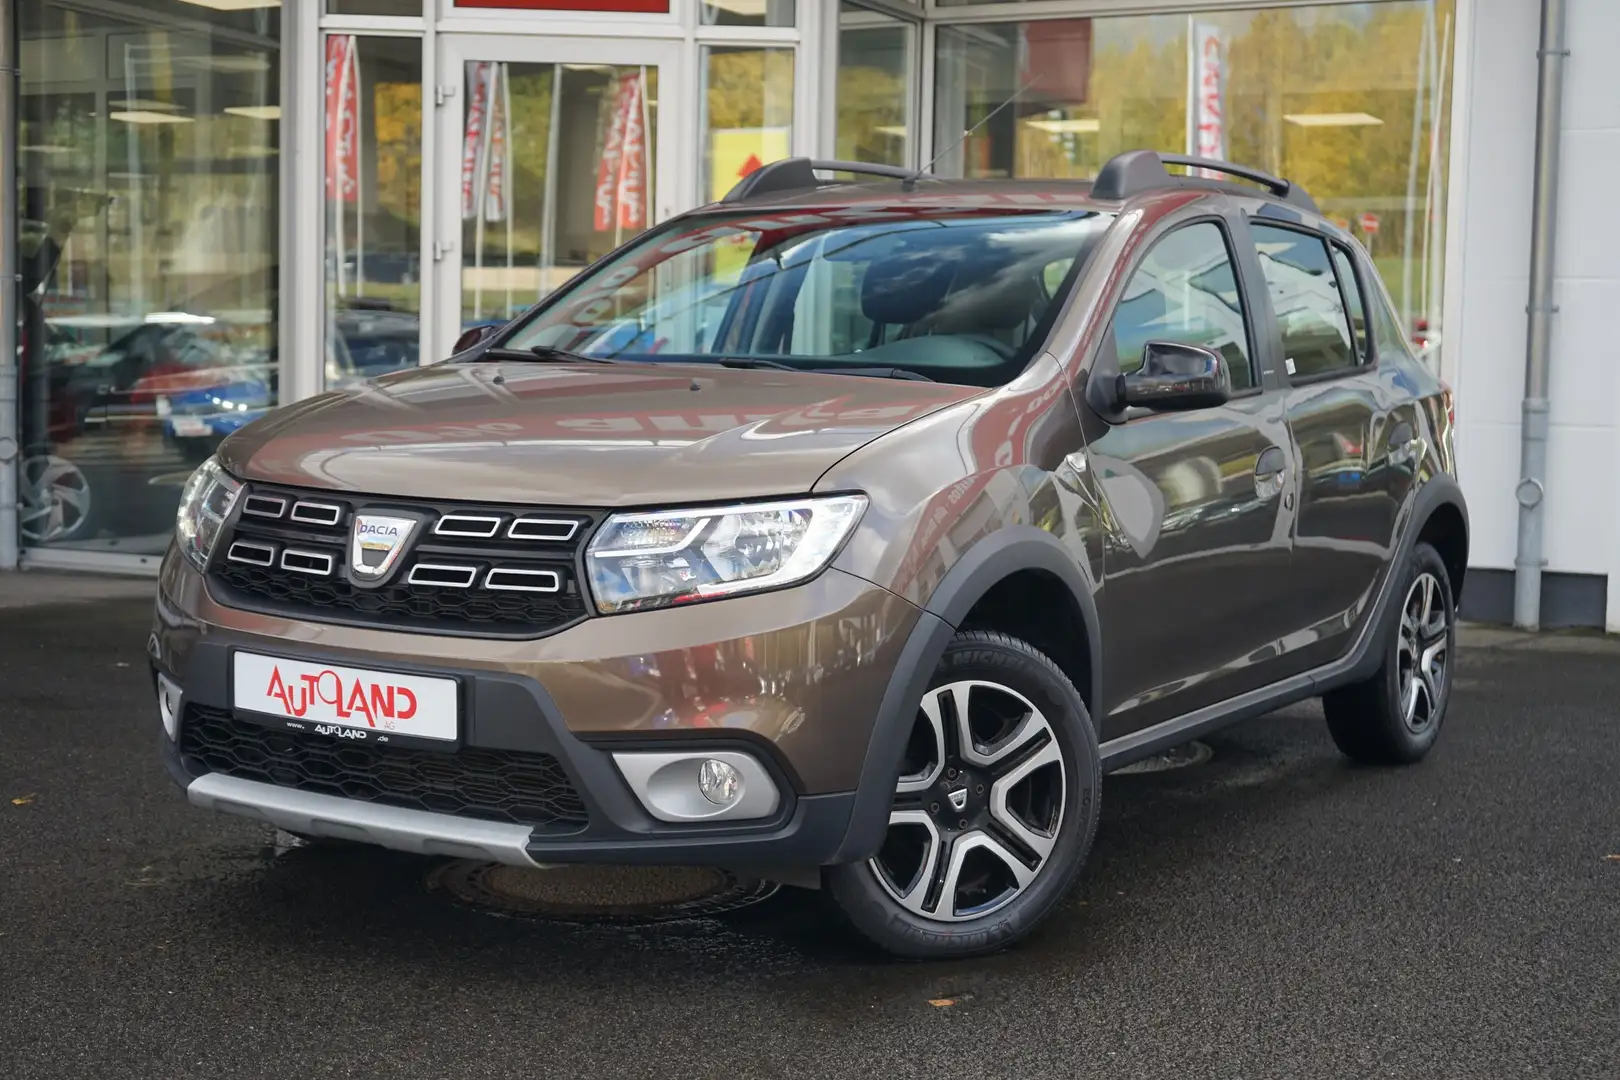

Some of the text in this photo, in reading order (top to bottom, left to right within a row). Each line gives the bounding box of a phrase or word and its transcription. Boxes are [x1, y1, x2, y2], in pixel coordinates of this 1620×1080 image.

[359, 524, 398, 537] DACIA
[266, 664, 418, 728] AUTOLAND
[286, 721, 305, 730] www.
[314, 724, 367, 740] AUTOLAND
[384, 719, 396, 731] AG
